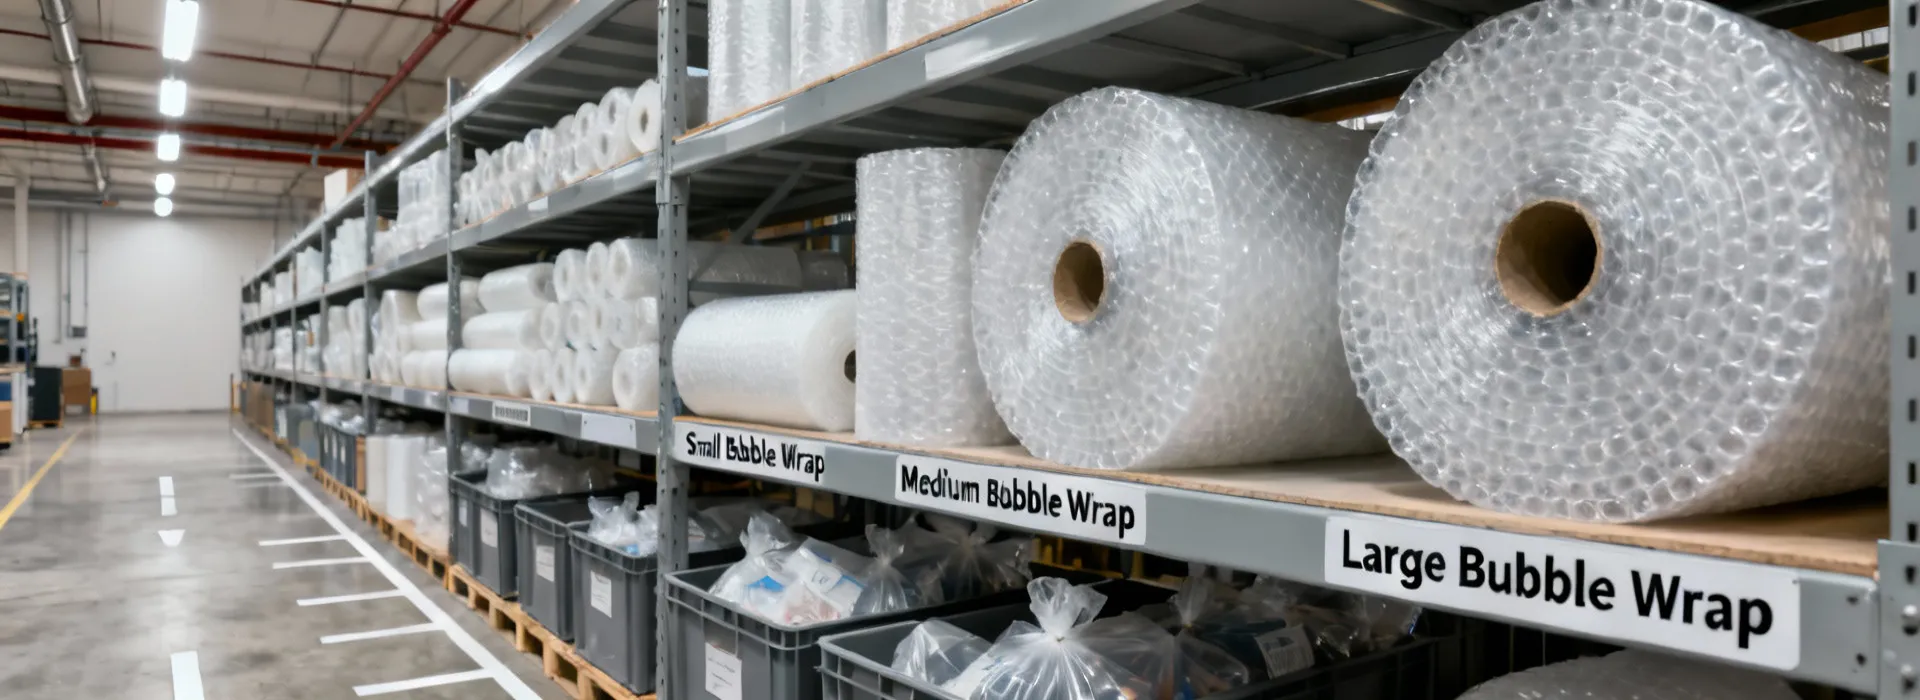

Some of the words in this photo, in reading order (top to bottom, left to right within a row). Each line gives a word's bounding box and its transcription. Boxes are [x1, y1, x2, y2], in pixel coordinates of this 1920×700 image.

[781, 442, 825, 482] Wrap
[901, 464, 980, 503] Medium
[1066, 488, 1135, 539] Wrap
[1342, 528, 1446, 590] Large
[1458, 545, 1616, 611] Bubble
[1630, 569, 1774, 649] Wrap
